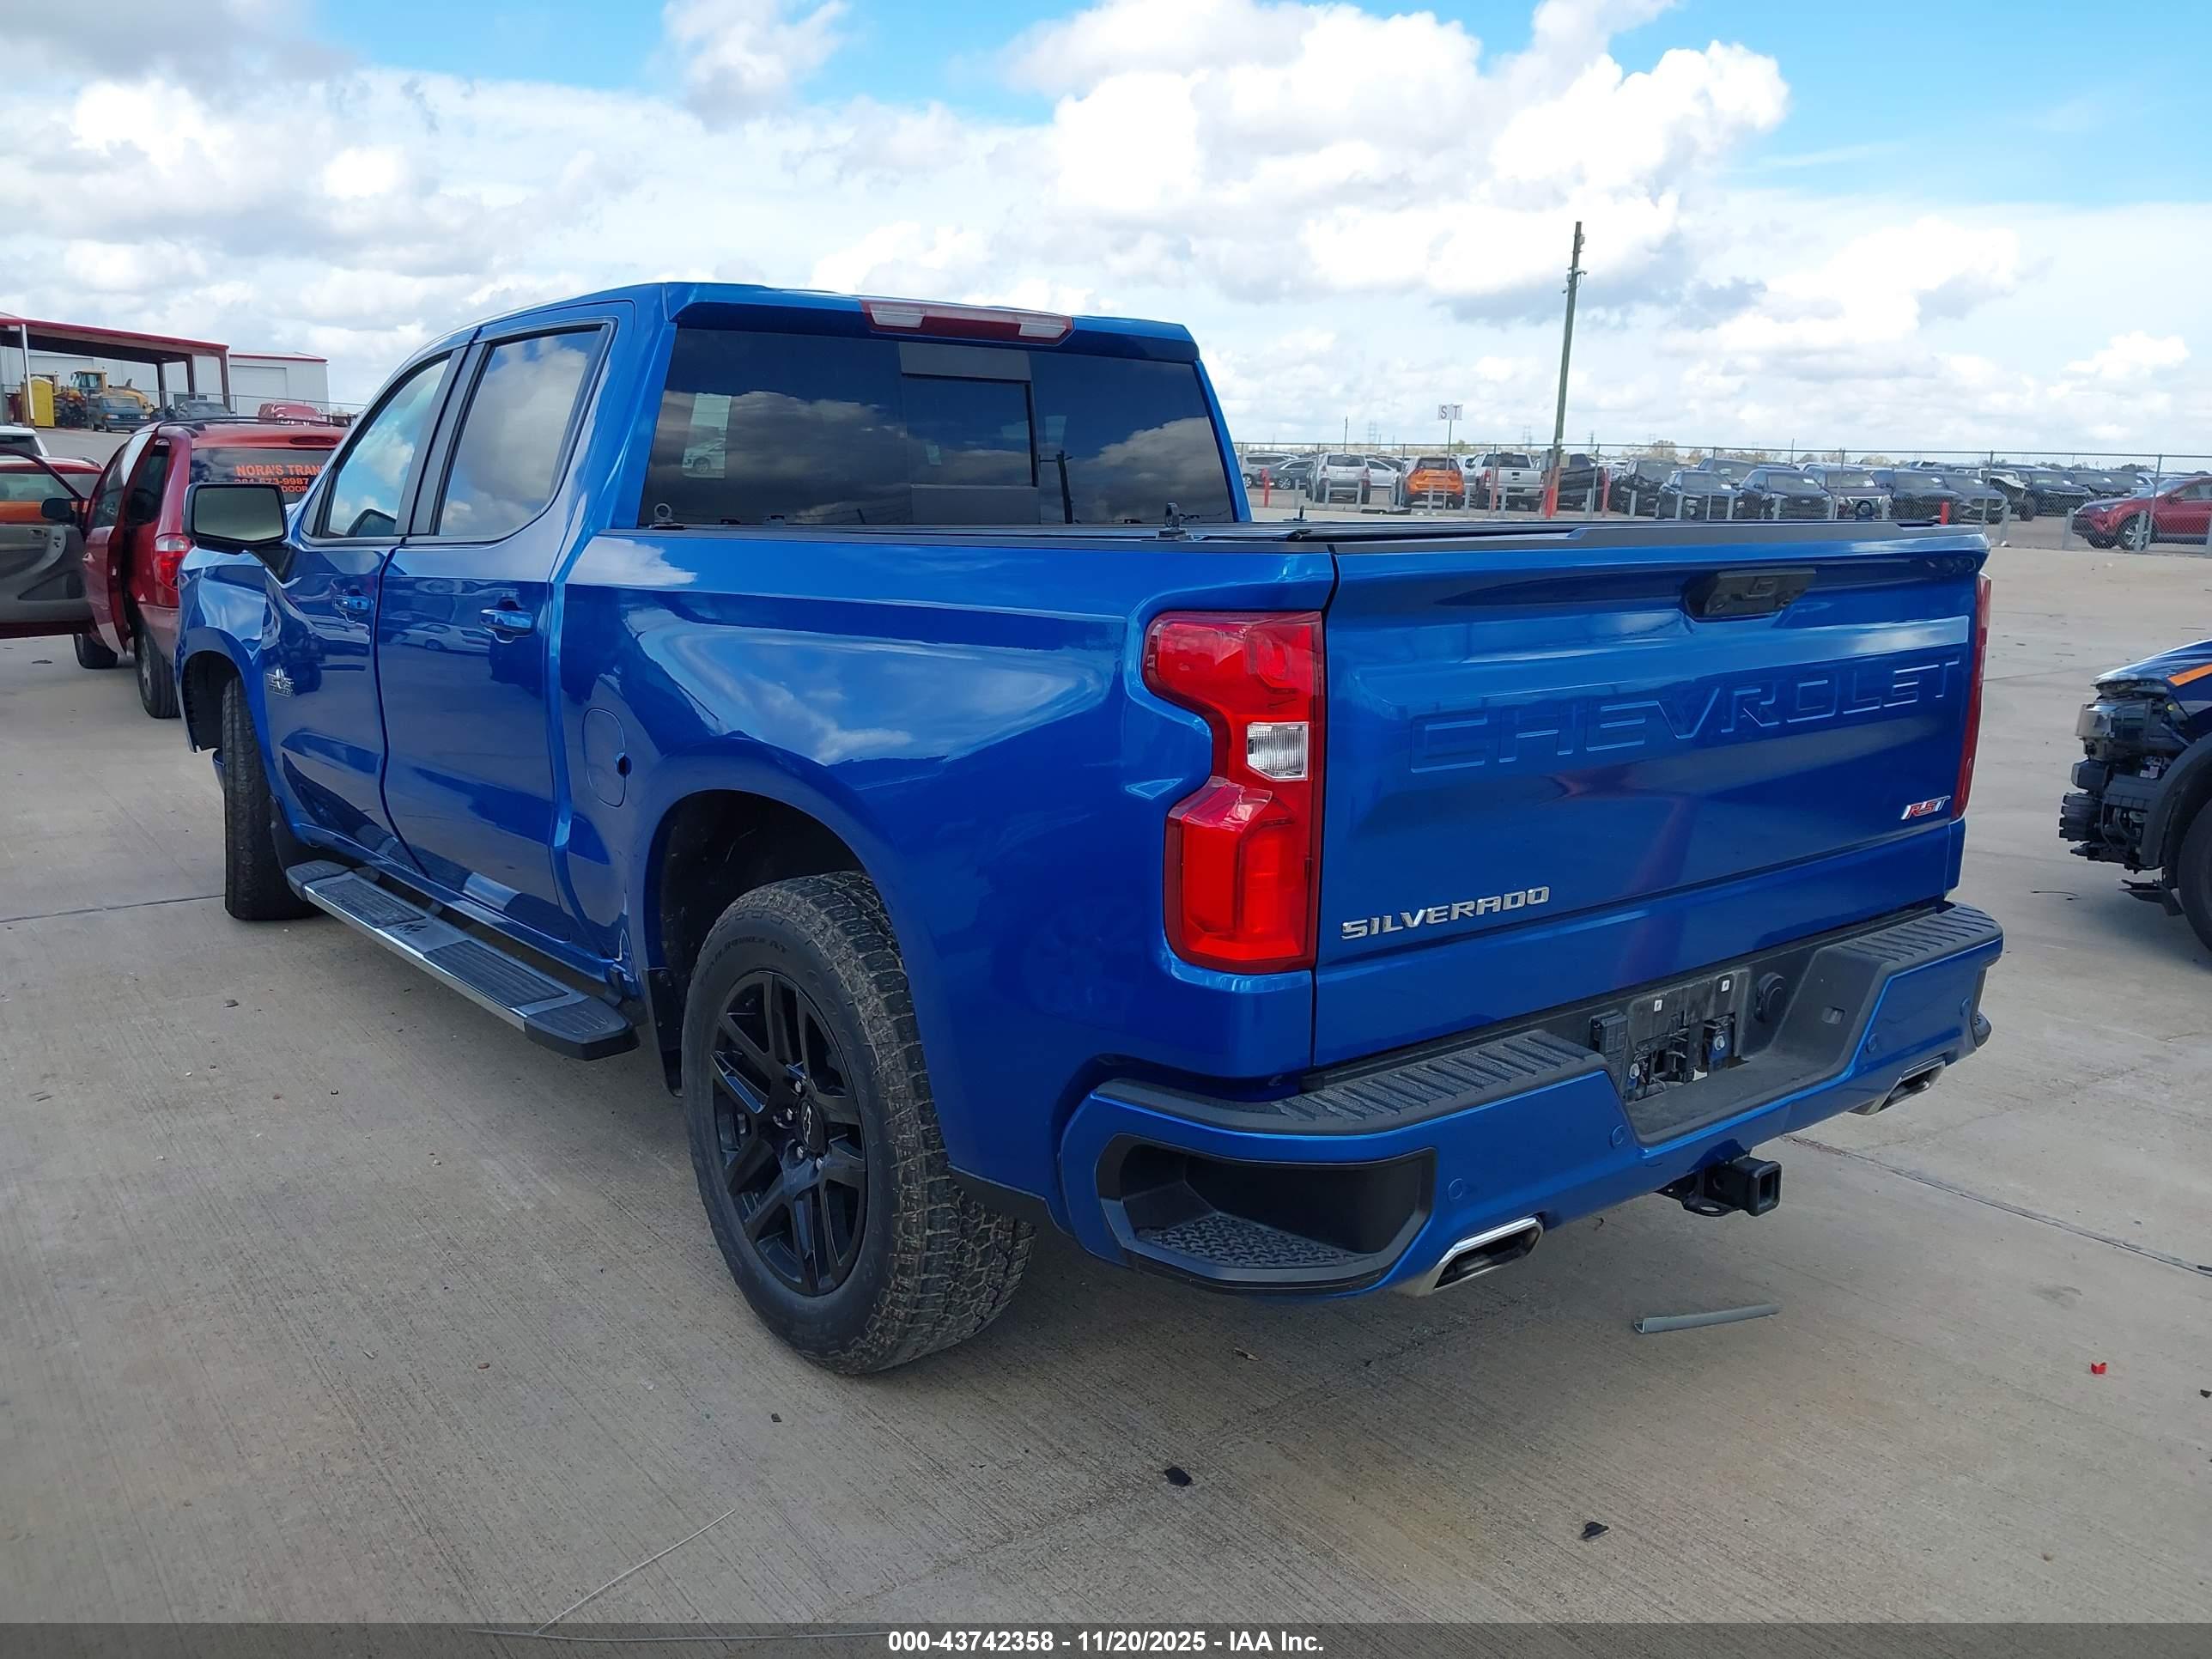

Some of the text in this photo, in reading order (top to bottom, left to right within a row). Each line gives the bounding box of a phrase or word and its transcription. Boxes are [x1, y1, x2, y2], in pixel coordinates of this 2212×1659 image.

[1440, 405, 1461, 420] S T
[235, 465, 323, 476] NORA'S TRAN
[1409, 655, 1960, 774] CHEVROLET
[1900, 795, 1951, 820] RST
[1340, 885, 1550, 940] SILVERADO
